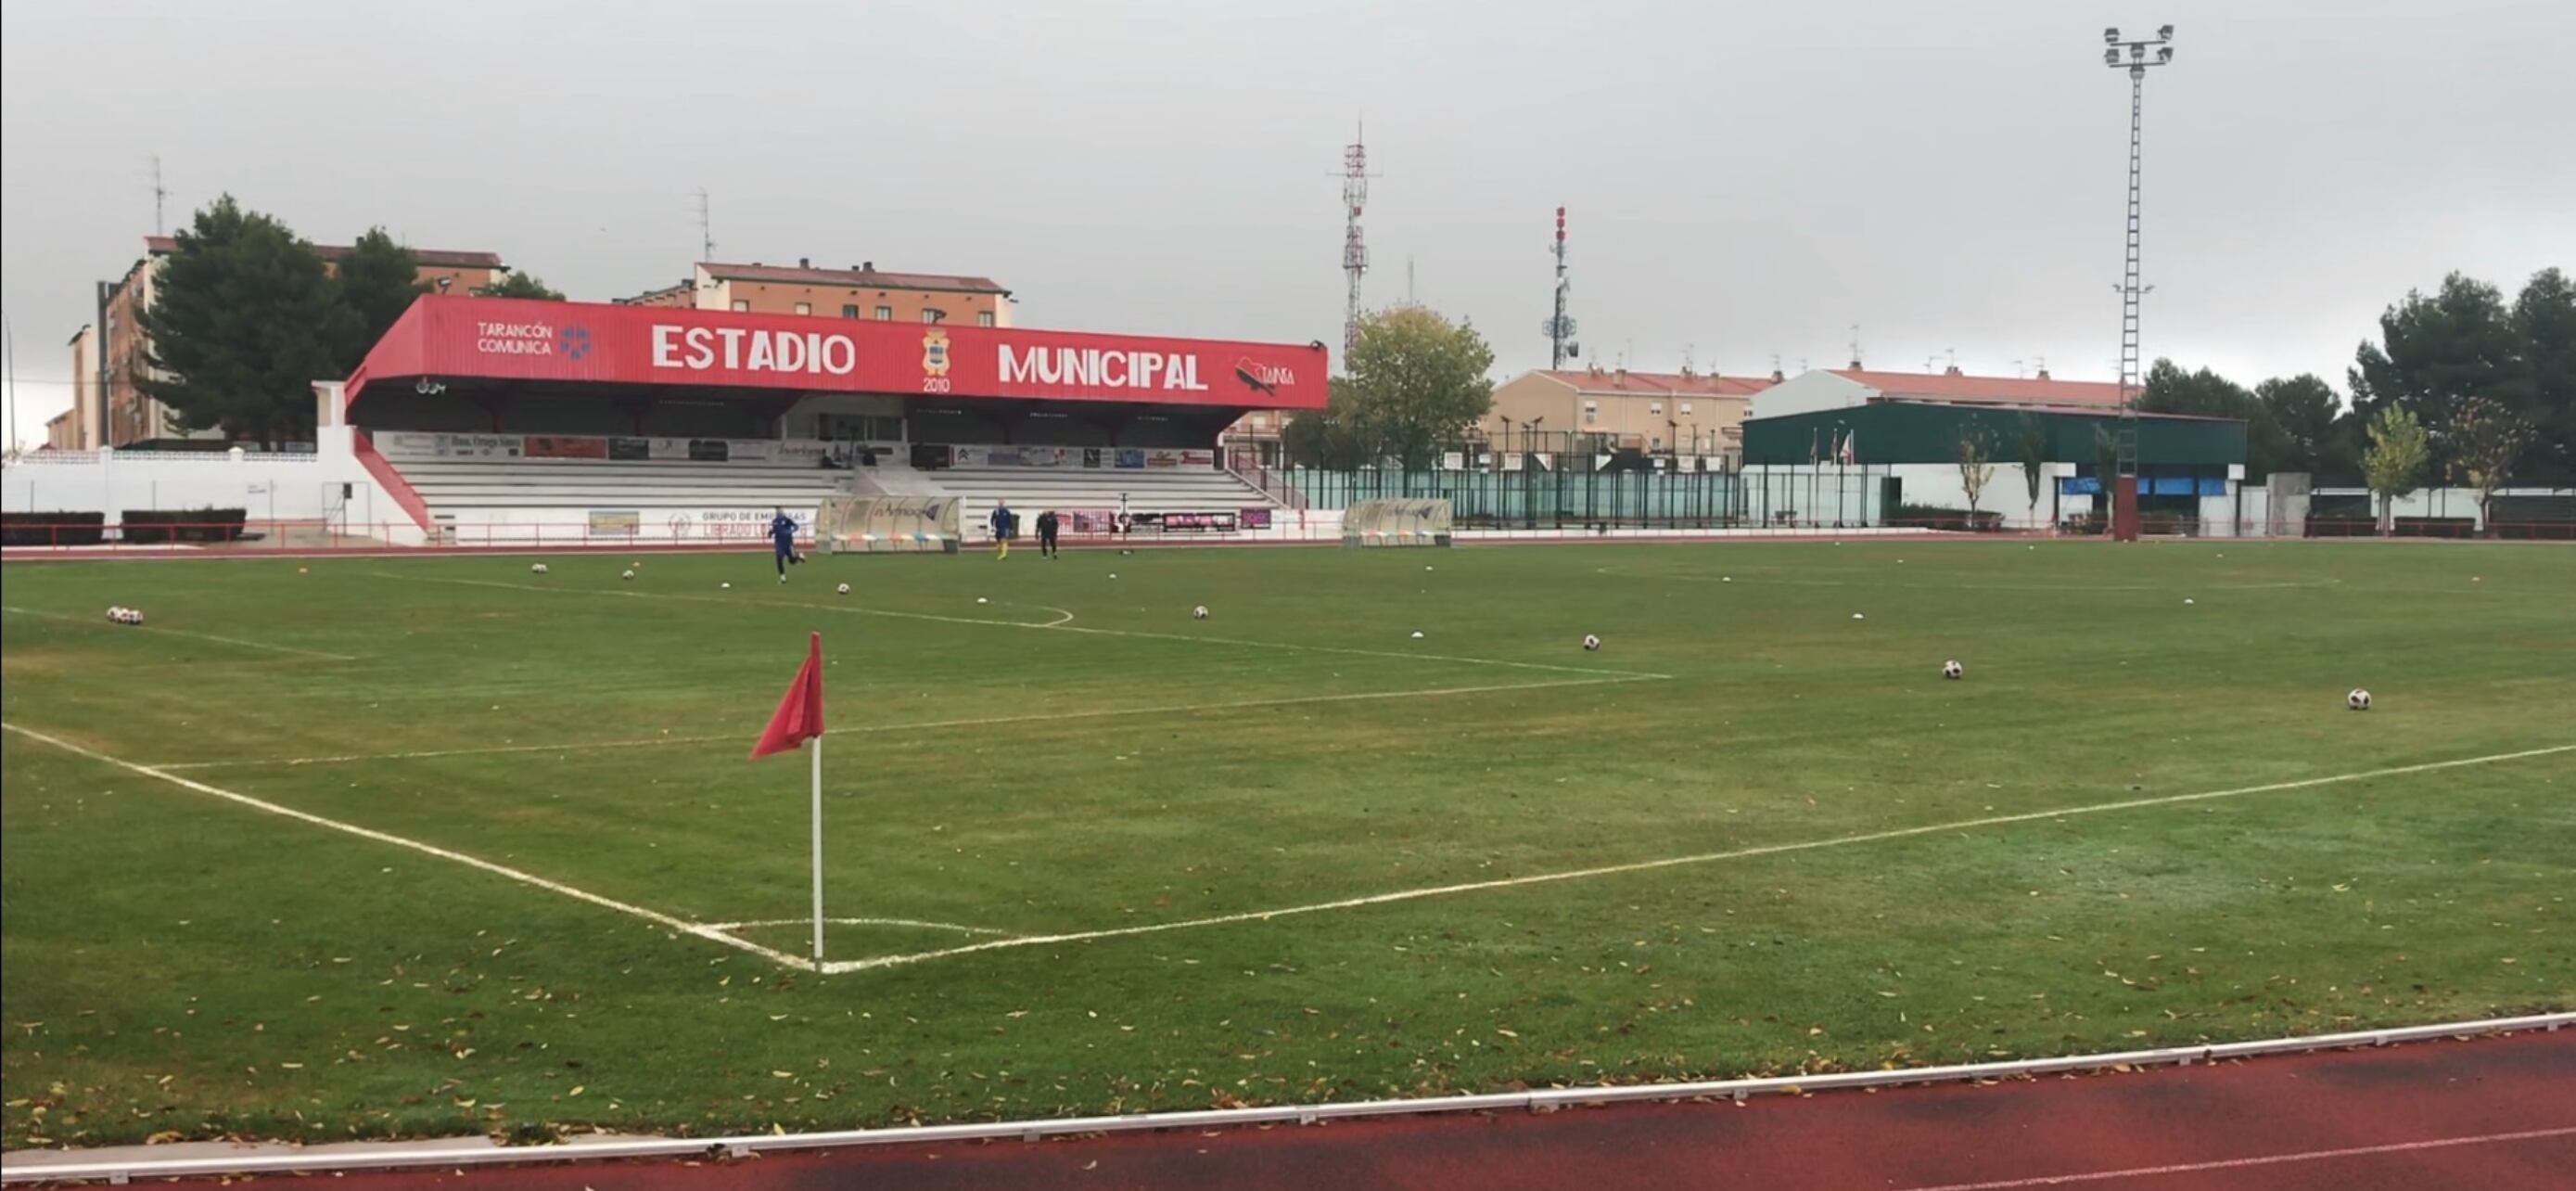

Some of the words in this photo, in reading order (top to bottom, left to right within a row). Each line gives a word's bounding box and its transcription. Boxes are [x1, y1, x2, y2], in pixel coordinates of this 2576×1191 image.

[478, 321, 553, 339] TARANCÓN
[478, 339, 552, 355] COMUNICA
[652, 324, 856, 376] ESTADIO
[998, 344, 1208, 391] MUNICIPAL
[924, 378, 951, 393] 2010
[703, 512, 735, 521] GRUPO
[739, 512, 751, 521] DE
